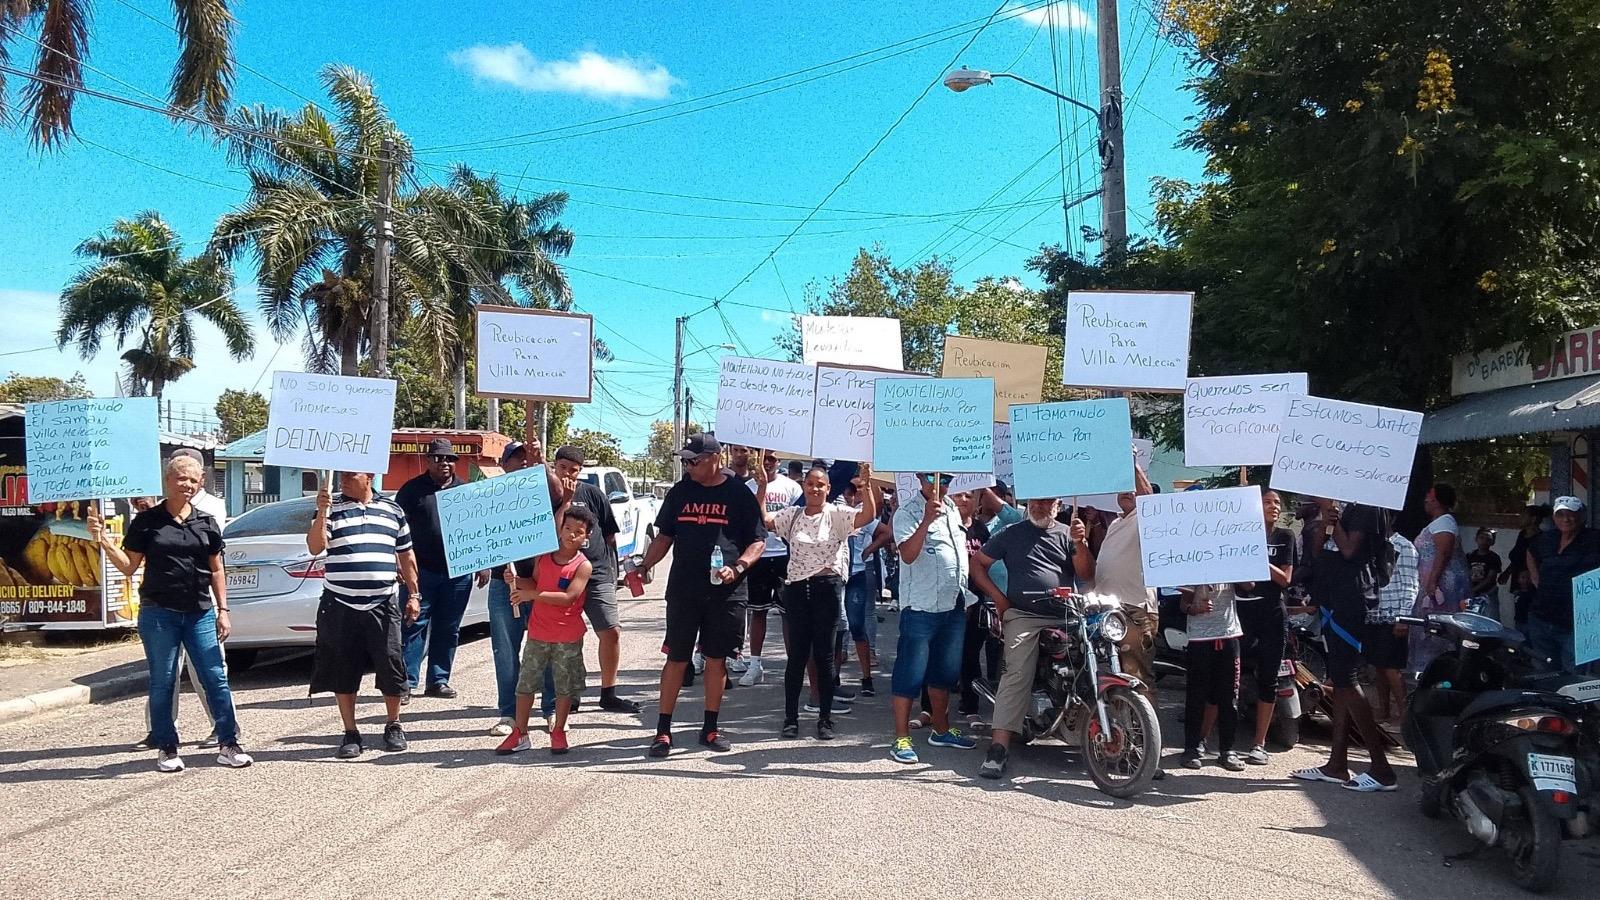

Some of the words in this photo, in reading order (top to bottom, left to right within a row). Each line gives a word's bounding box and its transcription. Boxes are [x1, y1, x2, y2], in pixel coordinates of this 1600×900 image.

[1109, 333, 1137, 347] Para
[513, 347, 540, 360] Para
[1081, 348, 1117, 366] Villa
[489, 363, 520, 378] Villa
[740, 379, 768, 392] desde
[770, 383, 785, 395] que
[845, 412, 875, 437] Pa
[419, 444, 425, 453] Y
[682, 503, 727, 516] AMIRI
[0, 585, 16, 598] CIO
[18, 585, 31, 598] DE
[32, 584, 75, 598] DELIVERY
[28, 600, 87, 614] 809-844-1848
[1578, 684, 1600, 692] HON
